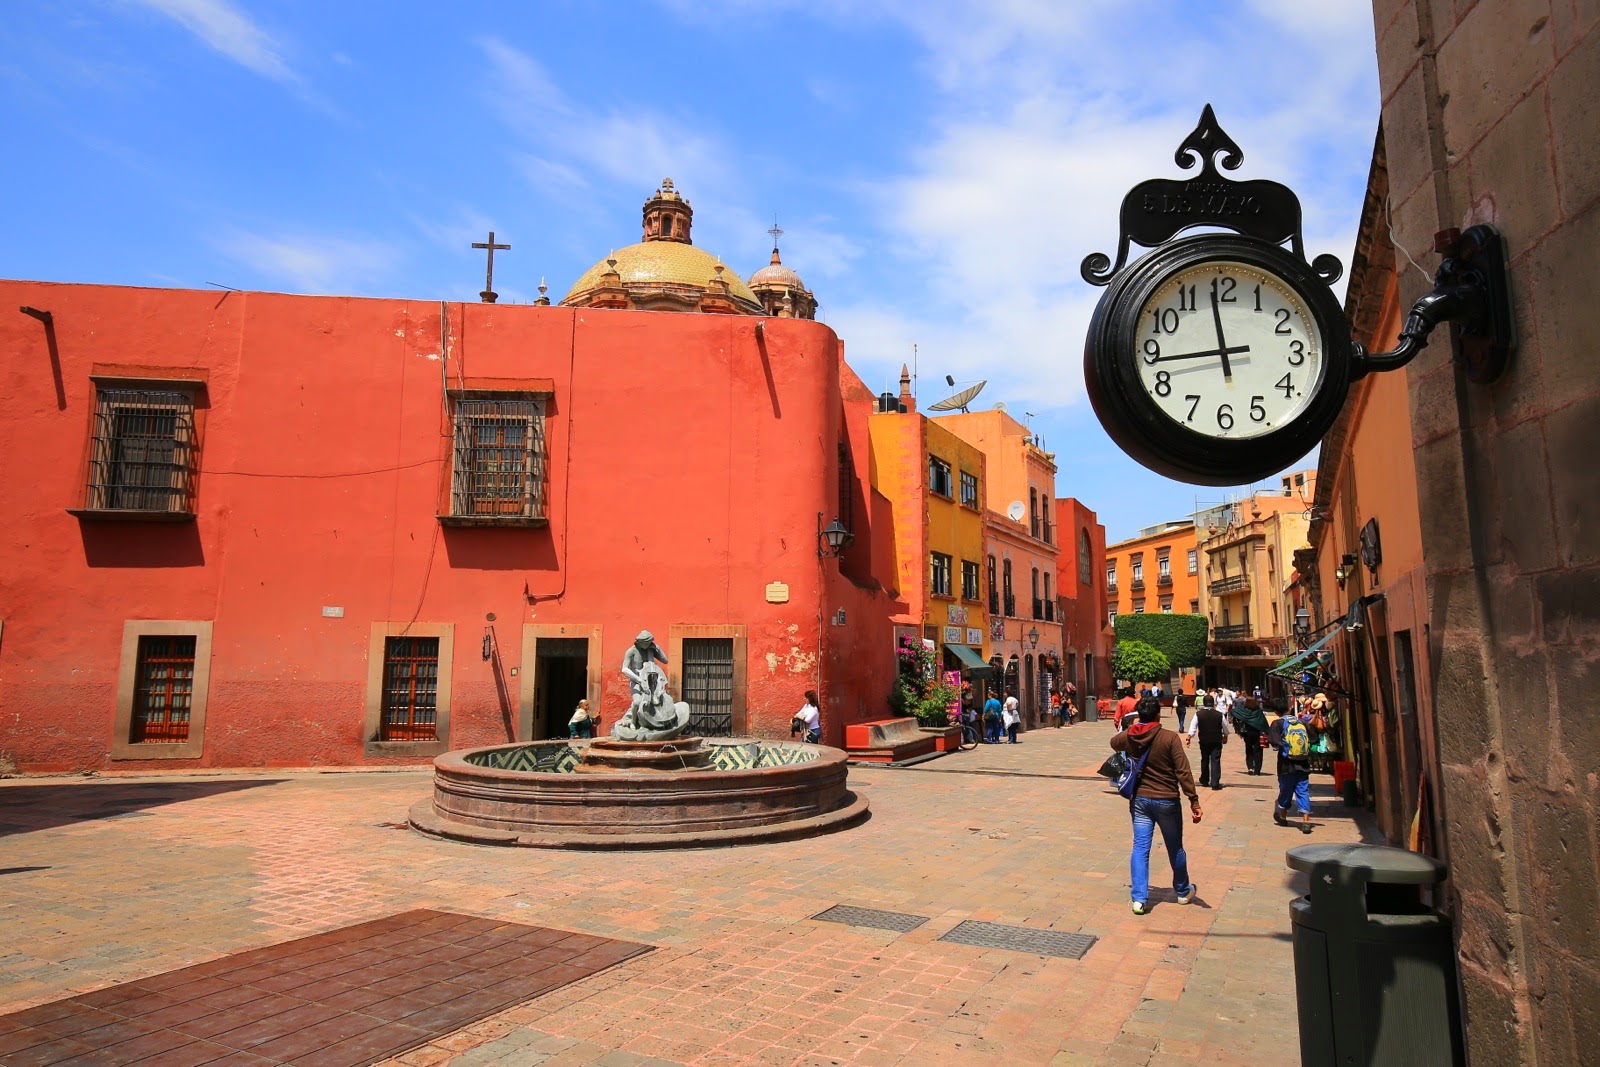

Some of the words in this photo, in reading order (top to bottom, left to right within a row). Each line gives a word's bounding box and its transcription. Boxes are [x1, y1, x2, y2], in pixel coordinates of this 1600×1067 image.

[1143, 194, 1155, 214] 5
[1163, 194, 1192, 214] DE
[1200, 194, 1264, 215] MAYO
[1178, 283, 1197, 312] 11
[1210, 276, 1237, 303] 12
[1253, 283, 1263, 312] 1
[1152, 307, 1180, 334] 10
[1274, 308, 1292, 334] 2
[1143, 338, 1161, 365] 9
[1288, 340, 1305, 366] 3
[1154, 370, 1172, 397] 8
[1274, 371, 1295, 398] 4
[1184, 394, 1201, 421] 7
[1216, 403, 1234, 430] 6
[1249, 395, 1266, 422] 5
